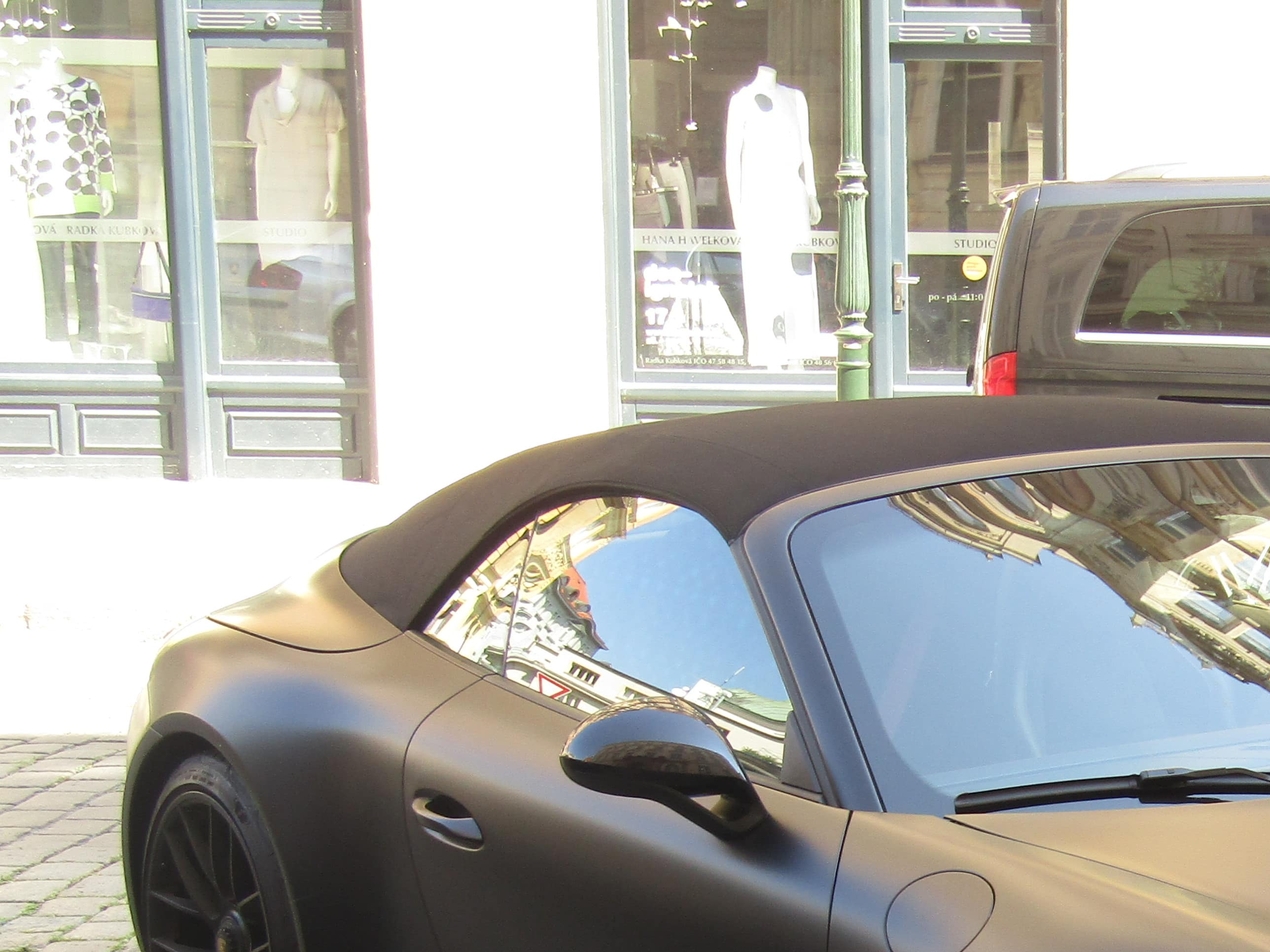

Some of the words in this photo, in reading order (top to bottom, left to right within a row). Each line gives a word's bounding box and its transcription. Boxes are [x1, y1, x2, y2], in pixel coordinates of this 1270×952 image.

[263, 226, 307, 238] STUDIO
[642, 235, 675, 245] HANA
[928, 294, 939, 303] po
